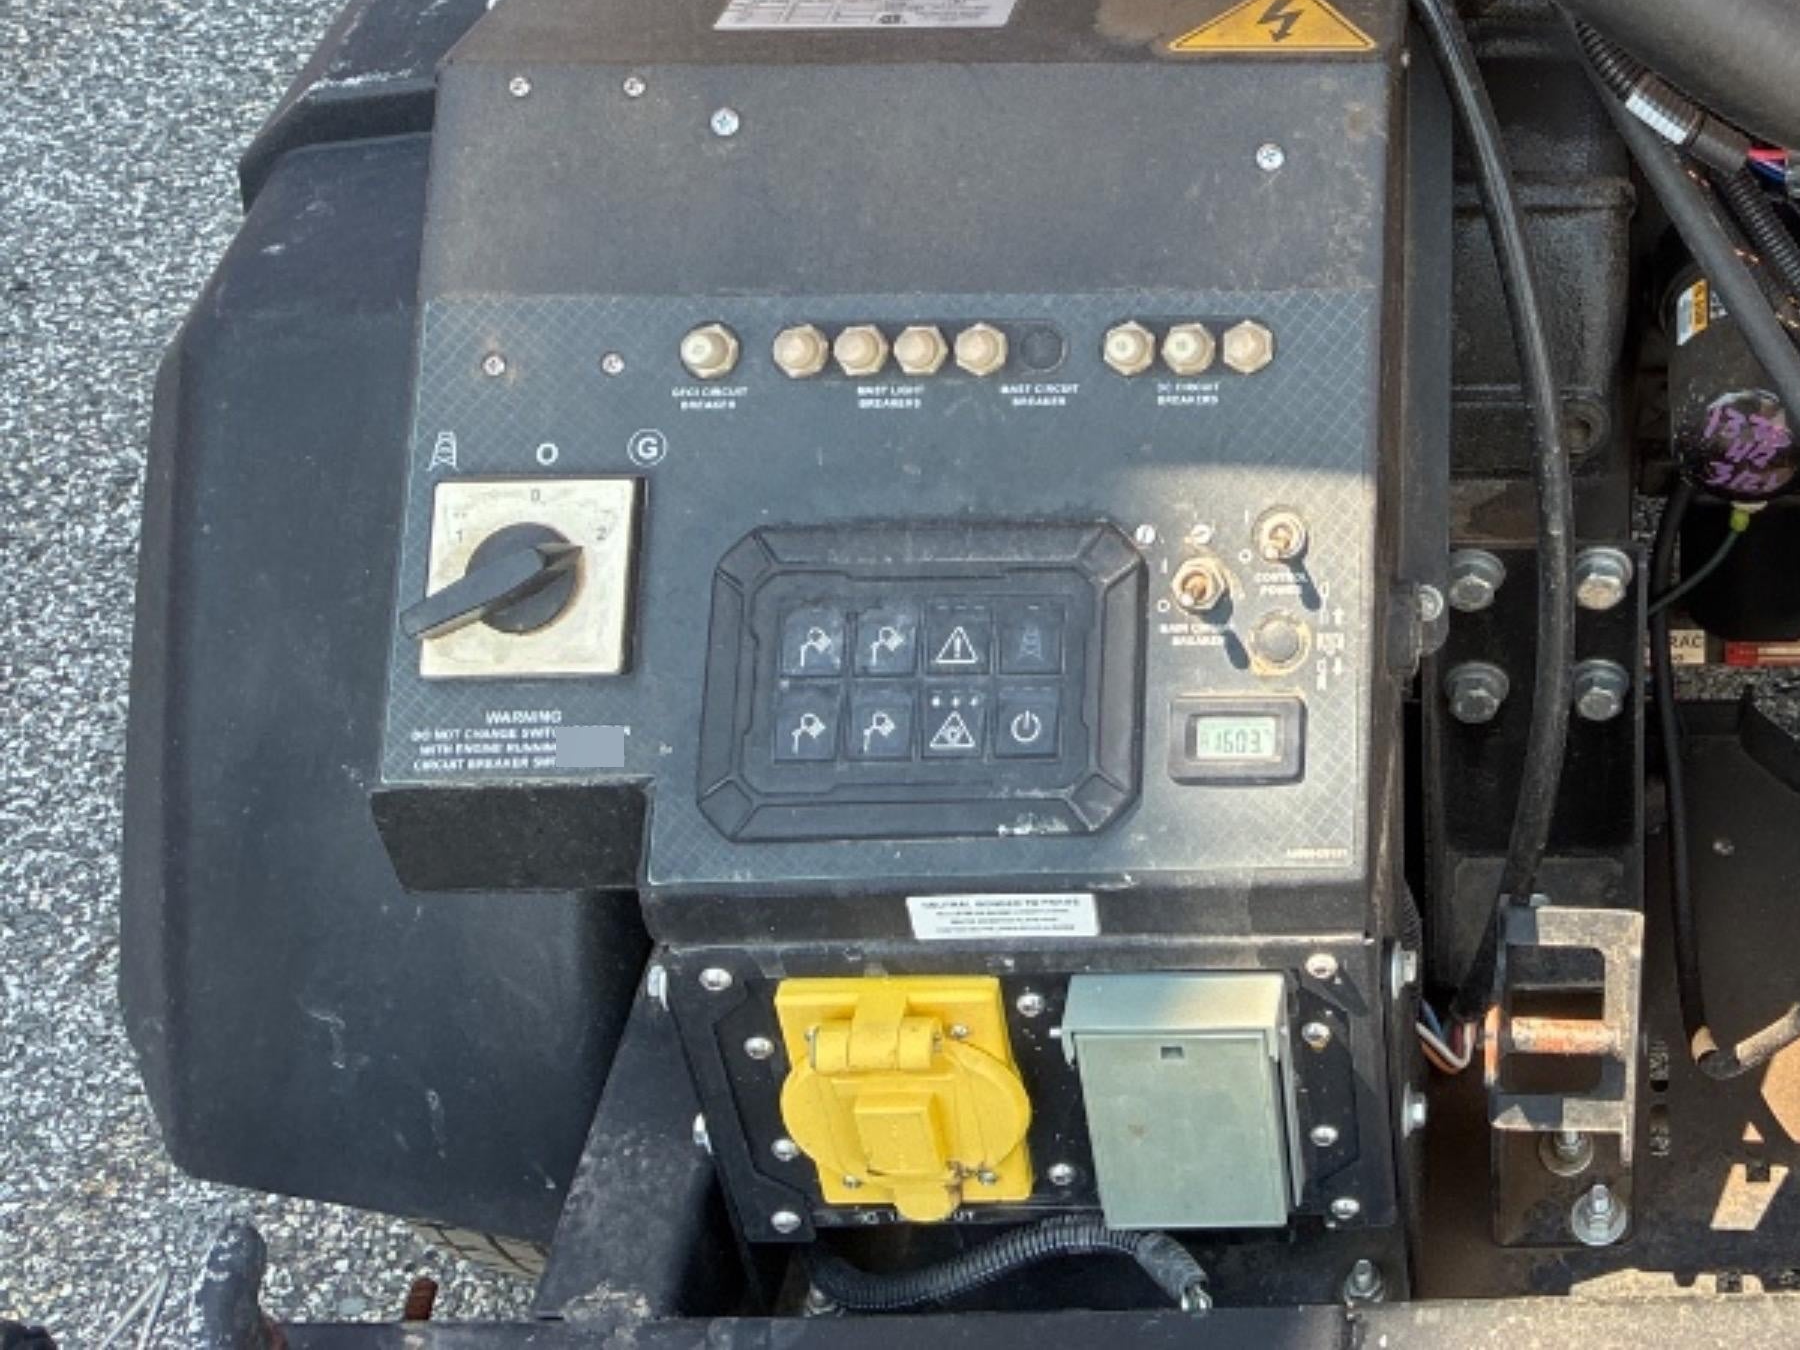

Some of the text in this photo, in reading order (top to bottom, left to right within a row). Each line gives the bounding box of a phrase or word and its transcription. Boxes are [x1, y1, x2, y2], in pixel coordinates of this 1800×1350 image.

[485, 710, 562, 724] WARNING
[434, 728, 461, 741] NOT
[464, 727, 517, 739] CHANGE
[467, 757, 529, 770] BREAKER
